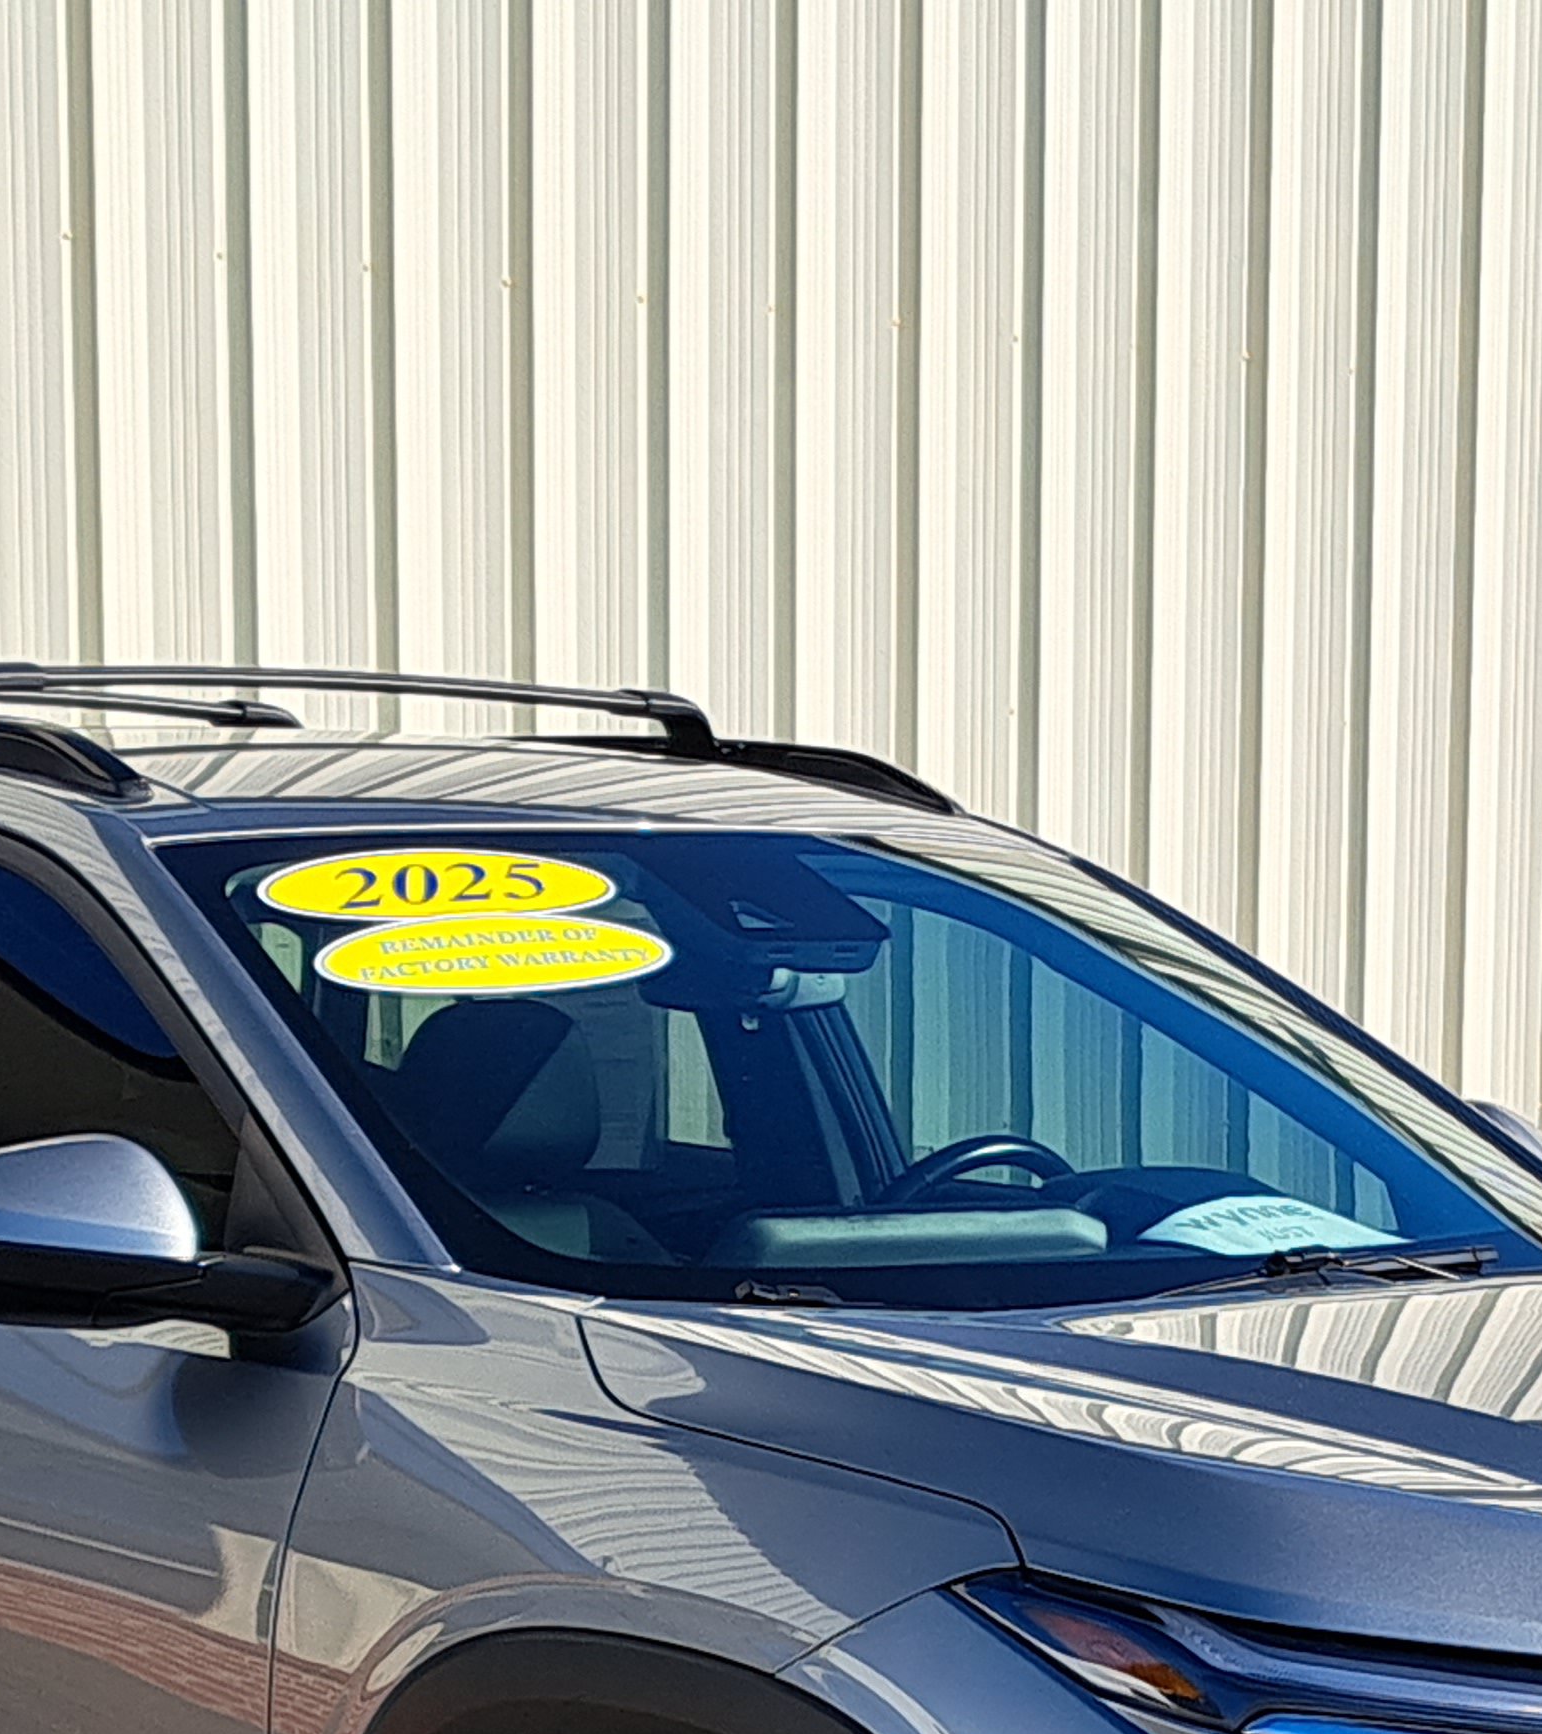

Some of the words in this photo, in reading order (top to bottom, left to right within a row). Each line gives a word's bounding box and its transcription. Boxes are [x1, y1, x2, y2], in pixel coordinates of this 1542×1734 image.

[334, 862, 546, 911] 2025
[378, 929, 557, 955] REMAINDER
[562, 927, 598, 942] OF
[359, 954, 492, 981] FACTORY
[497, 947, 651, 969] WARRANTY
